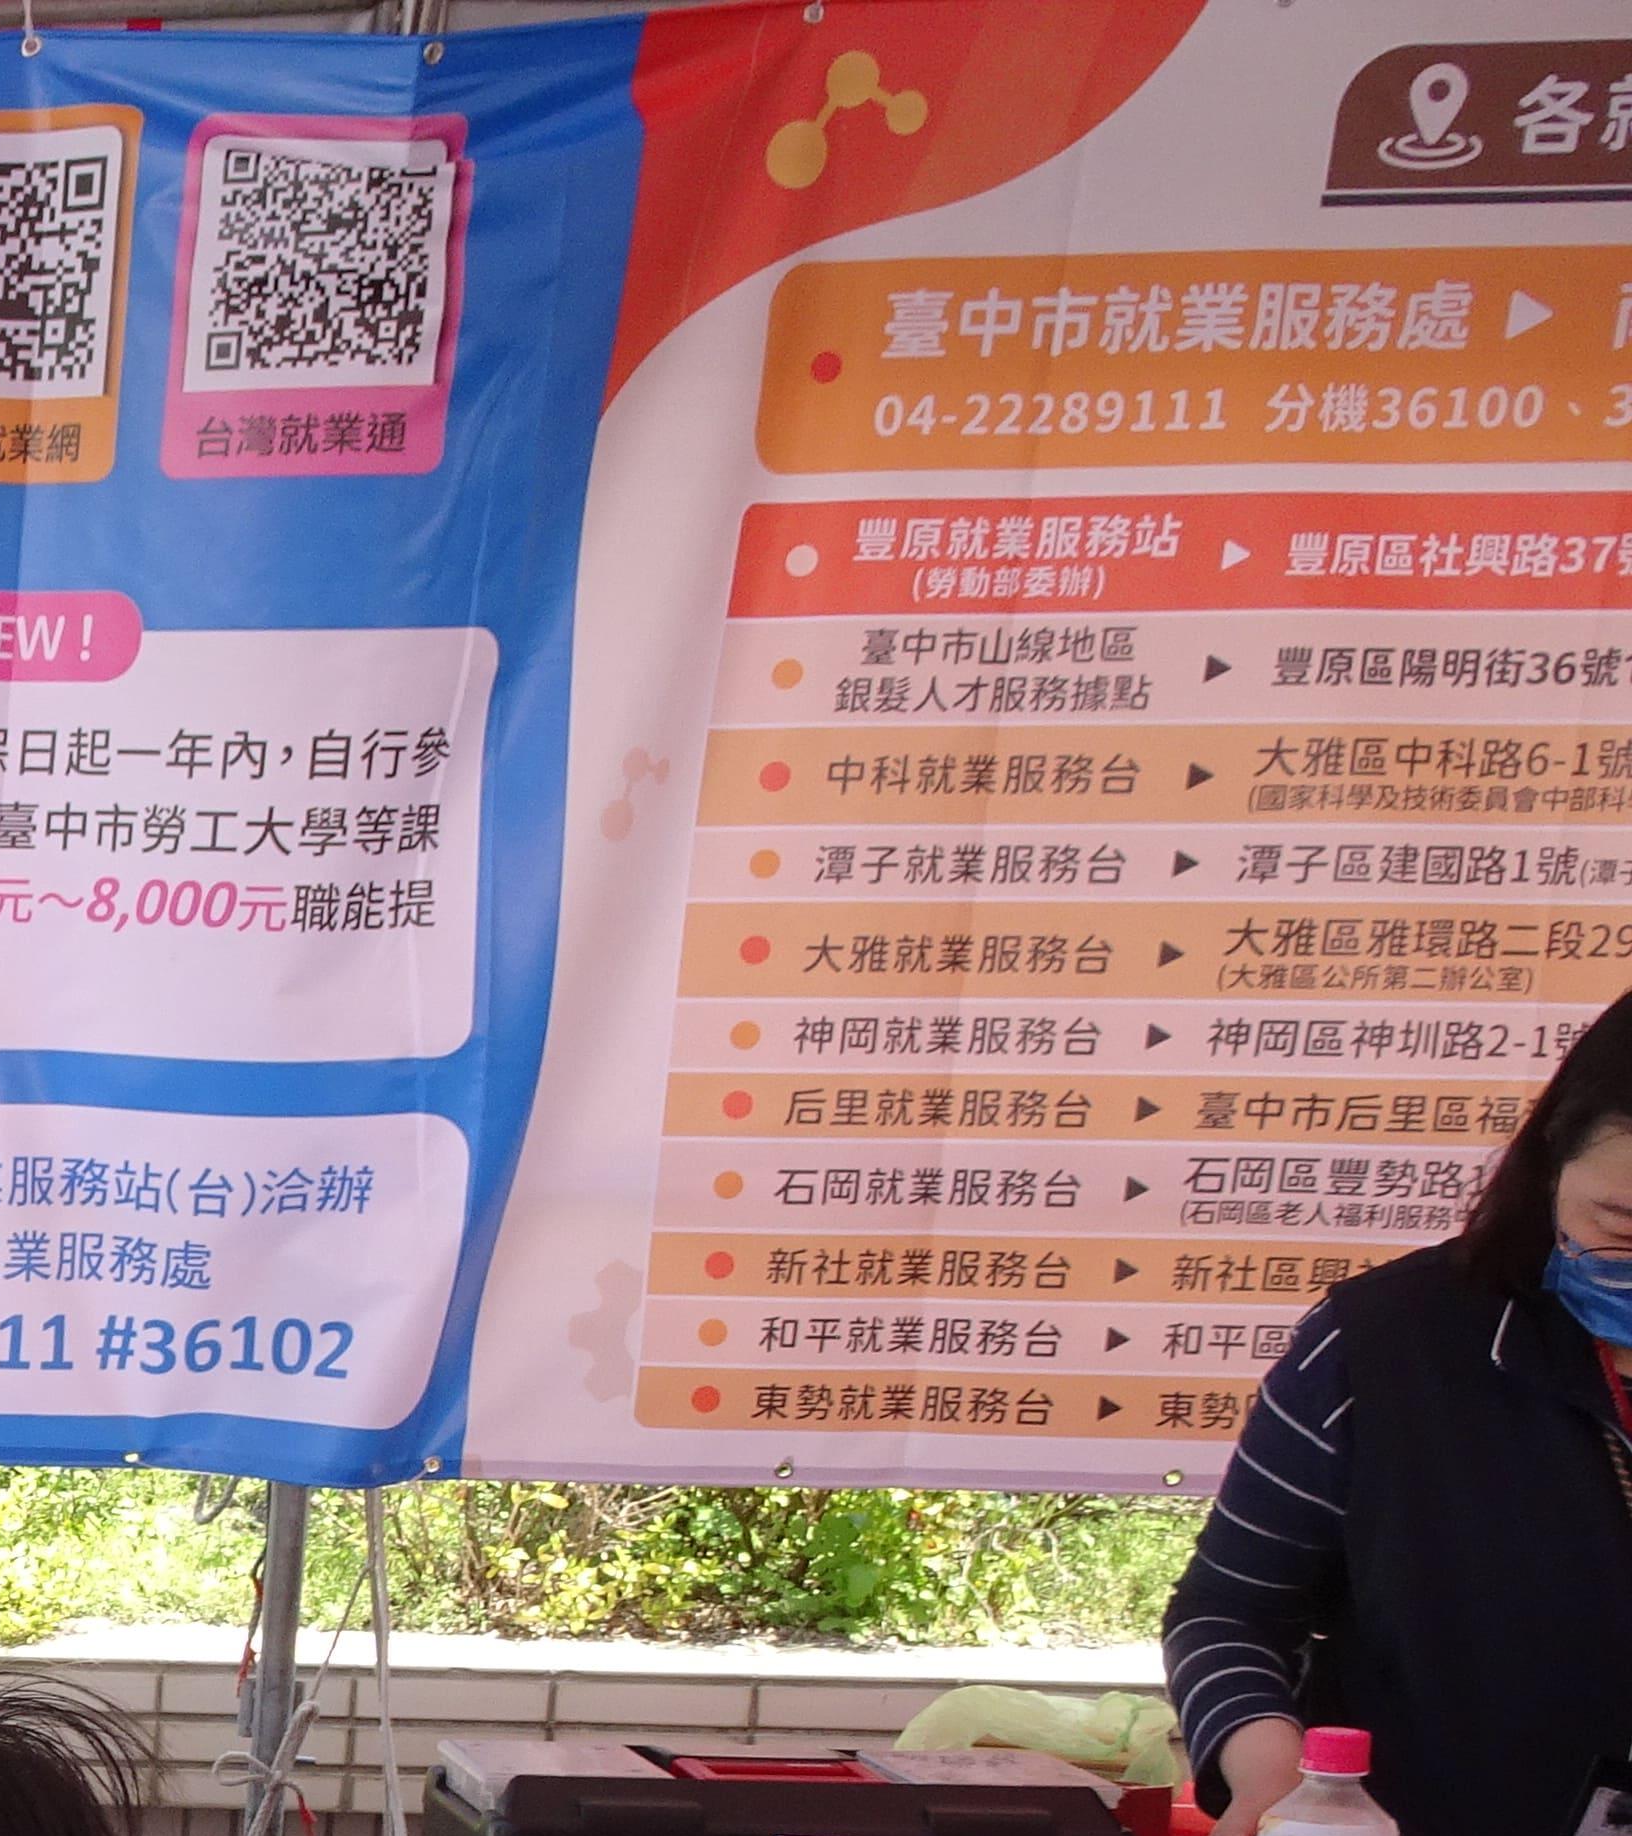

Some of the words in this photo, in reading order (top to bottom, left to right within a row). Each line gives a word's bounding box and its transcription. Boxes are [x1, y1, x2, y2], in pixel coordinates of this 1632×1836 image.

[881, 280, 1473, 360] 臺中市就業服務處
[874, 388, 1227, 439] 04-22289111
[195, 412, 408, 459] 台灣就業通
[852, 512, 1183, 562] 豐原就業服務站
[911, 565, 1107, 602] (勞動部委辦)
[861, 625, 1139, 667] 臺中市山線地區
[833, 674, 1153, 714] 銀髮人才服務據點
[826, 753, 1142, 797] 中科就業服務台
[814, 843, 1127, 887] 潭子就業服務台
[803, 934, 1114, 977] 大雅就業服務台
[1216, 962, 1534, 994] (大雅區公所第二辦公室)
[793, 1015, 1102, 1057] 神岡就業服務台
[783, 1088, 1093, 1129] 后里就業服務台
[1194, 1090, 1538, 1134] 臺中市后里區福
[773, 1167, 1081, 1209] 石岡就業服務台
[765, 1247, 1073, 1291] 新社就業服務台
[96, 1314, 355, 1380] #36102
[758, 1316, 1063, 1359] 和平就業服務台
[751, 1383, 1054, 1427] 東勢就業服務台
[1154, 1390, 1260, 1430] 東勢
